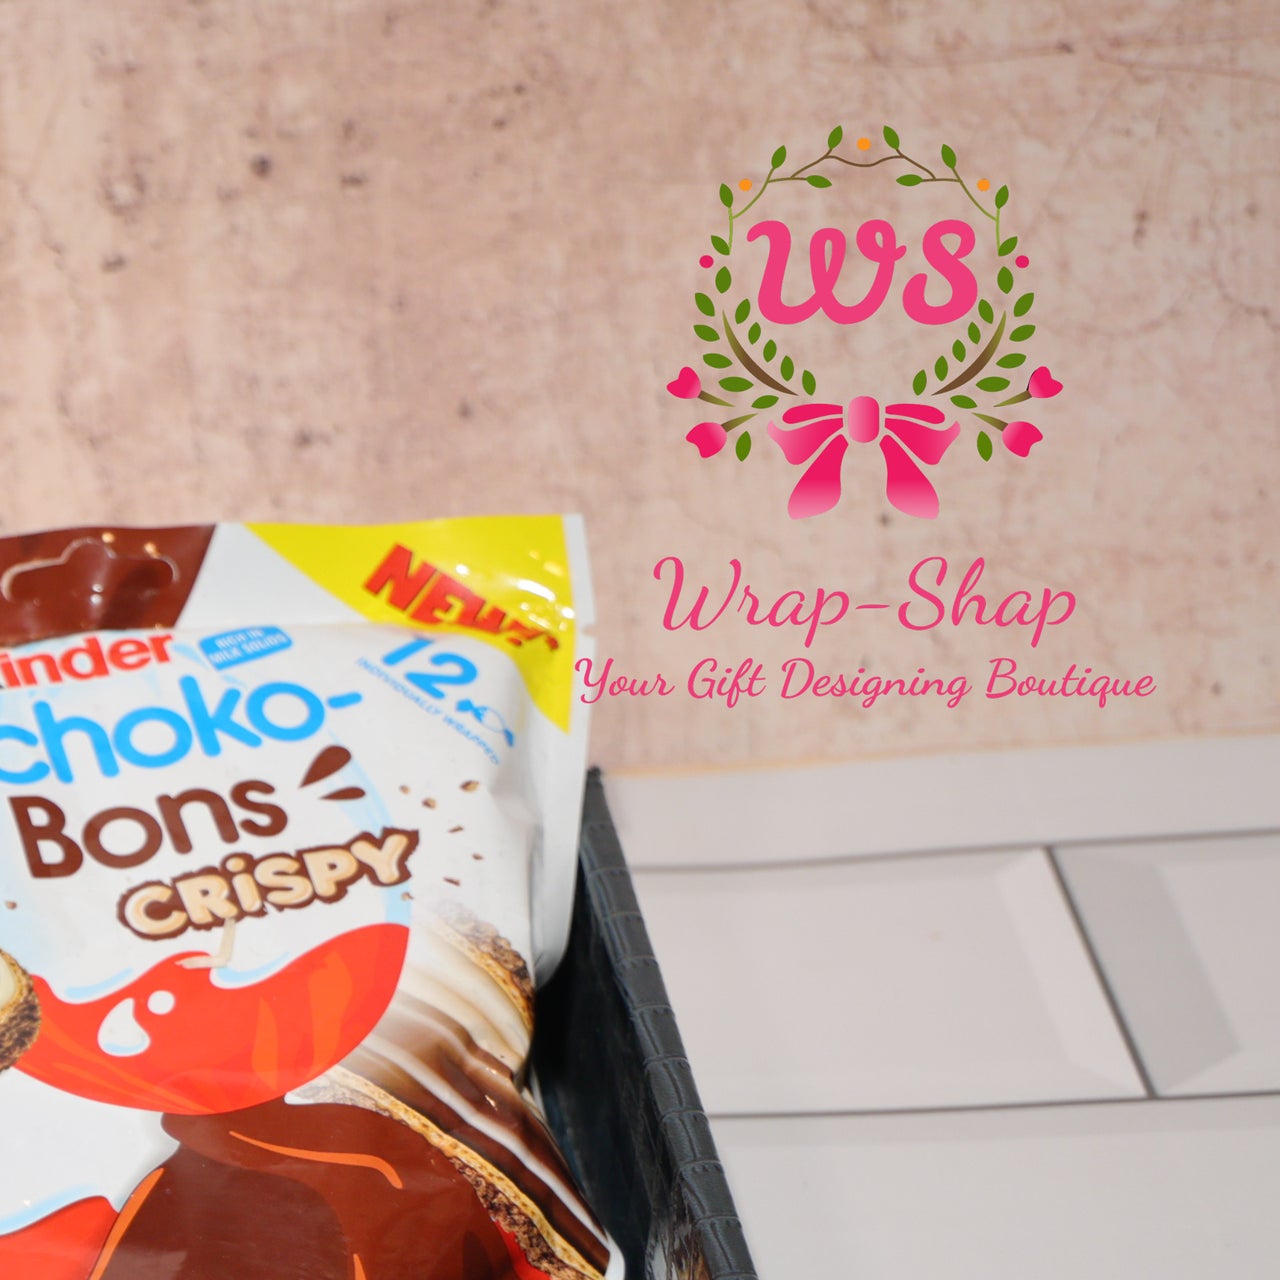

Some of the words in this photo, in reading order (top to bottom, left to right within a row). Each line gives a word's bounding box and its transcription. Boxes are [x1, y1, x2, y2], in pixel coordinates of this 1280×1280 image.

[356, 657, 441, 716] INDIVIDUALLY
[381, 636, 478, 699] 12
[8, 779, 288, 879] Bons
